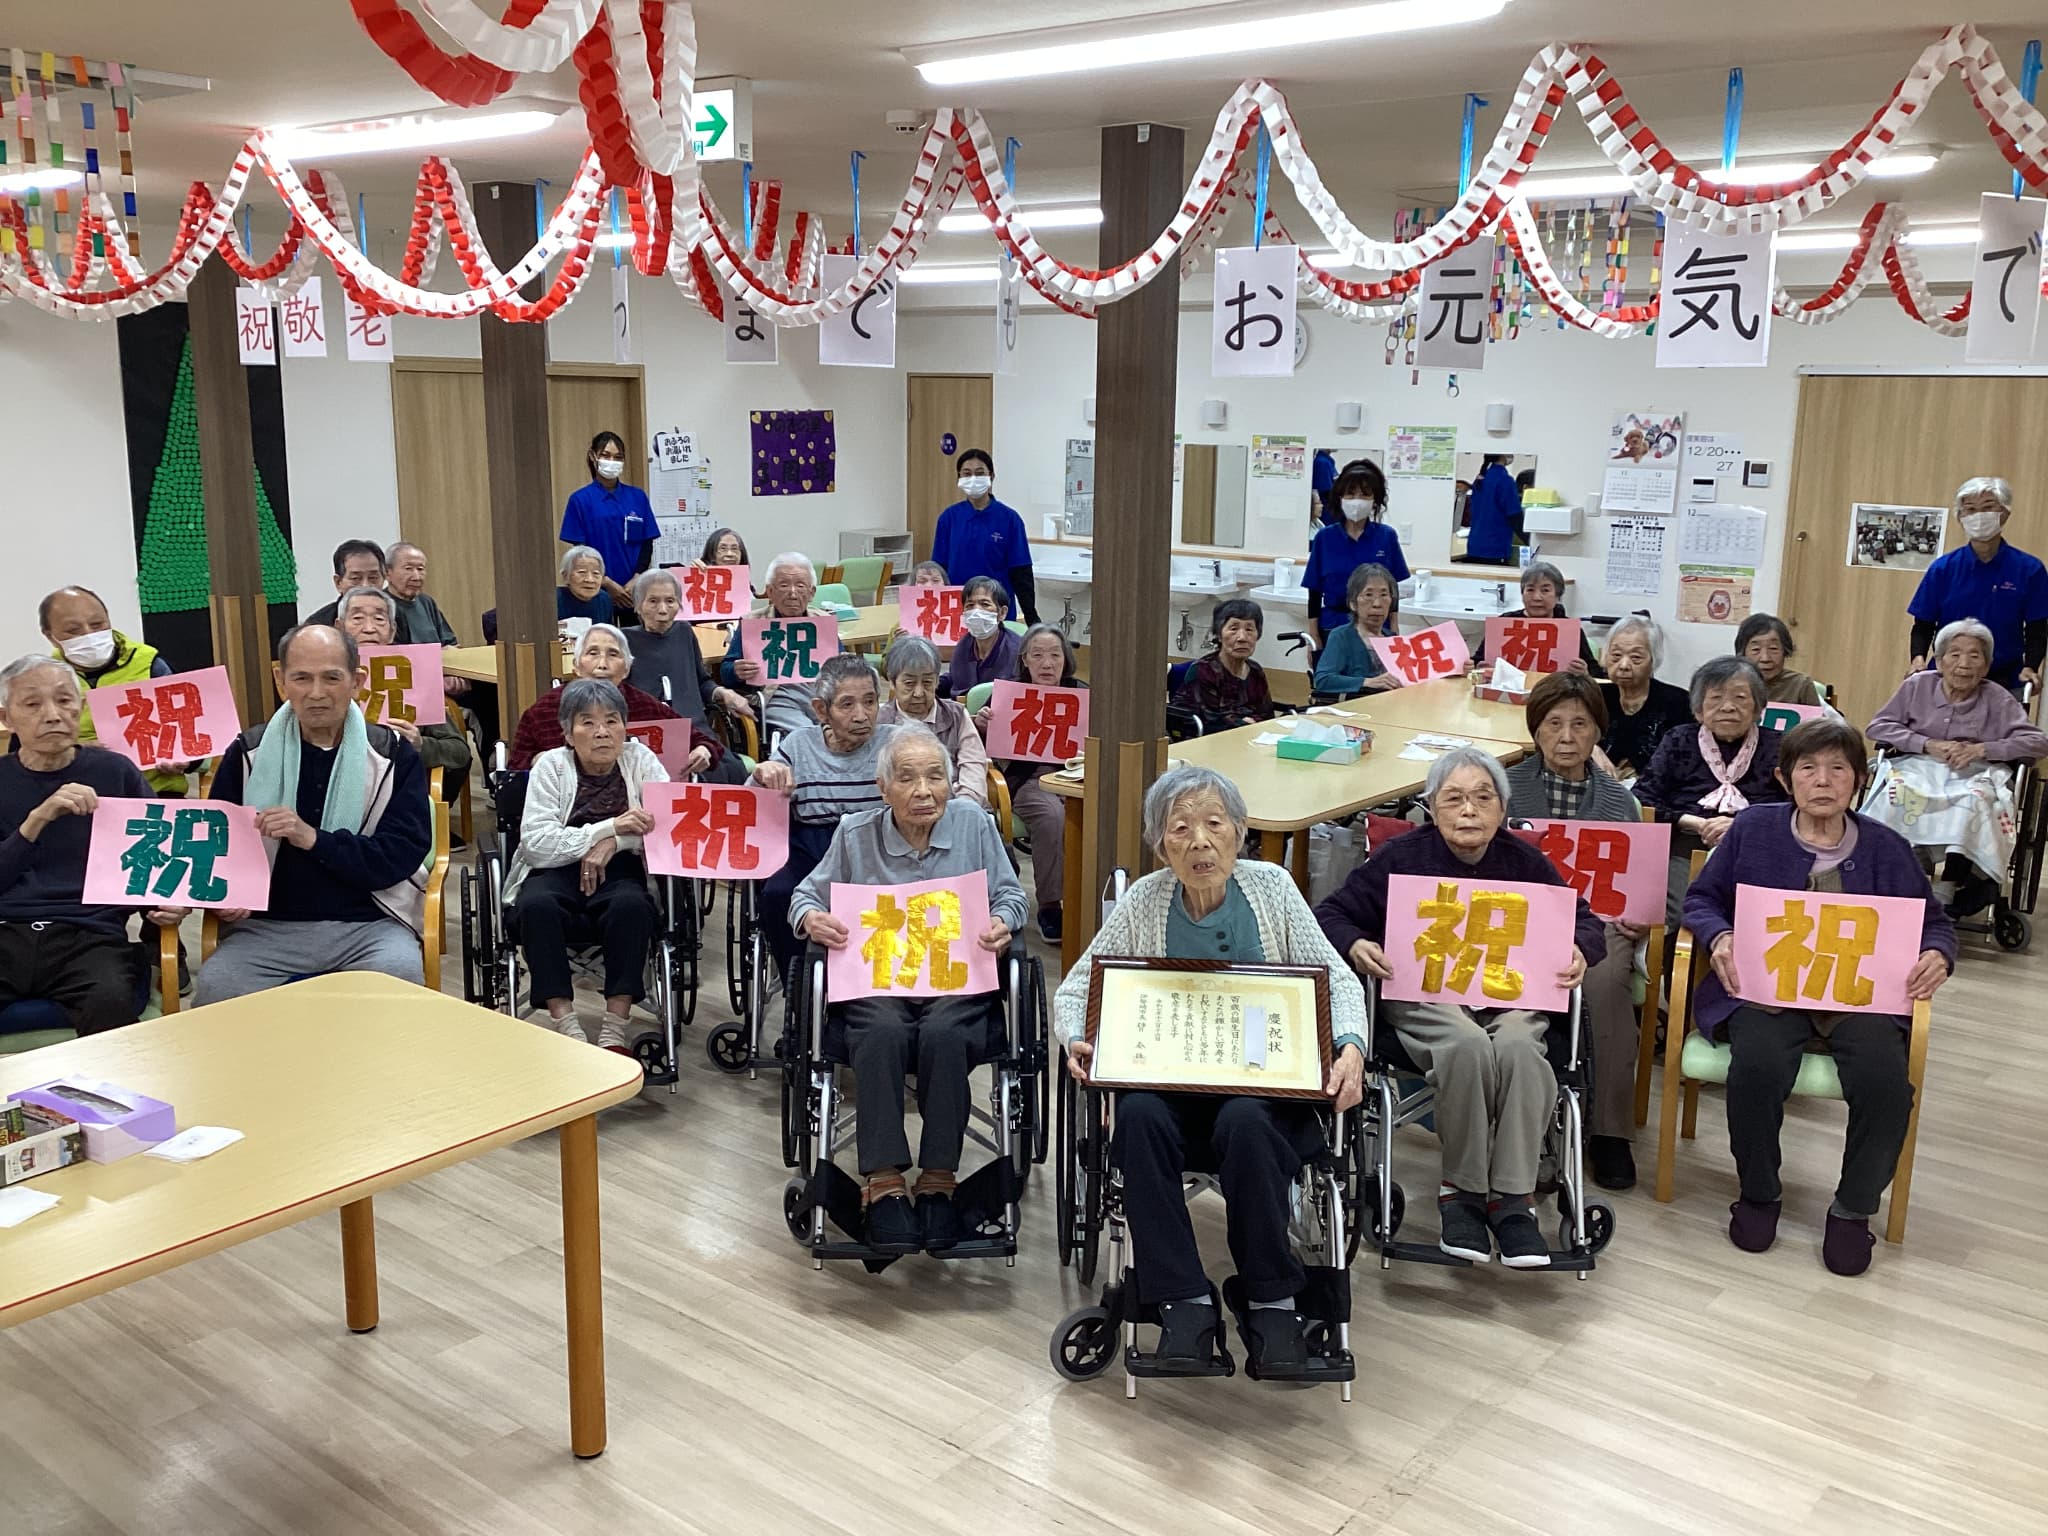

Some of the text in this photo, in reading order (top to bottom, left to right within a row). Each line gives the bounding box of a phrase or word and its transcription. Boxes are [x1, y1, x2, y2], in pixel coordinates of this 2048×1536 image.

[1423, 269, 1484, 344] 元
[1669, 247, 1760, 340] 気
[1983, 230, 2043, 323] で
[240, 303, 272, 351] 祝
[283, 295, 324, 343] 敬
[1225, 280, 1283, 351] お
[664, 435, 690, 446] おふろの
[670, 455, 689, 464] ました
[1716, 461, 1734, 472] 27
[1687, 509, 1697, 517] 12
[685, 568, 732, 614] 祝
[917, 591, 967, 643] 祝
[763, 622, 819, 679] 祝
[1390, 631, 1453, 680] 祝
[1502, 620, 1558, 673] 祝
[117, 683, 212, 767] 祝
[1011, 689, 1079, 759] 祝
[121, 804, 229, 901] 祝
[671, 786, 758, 869] 祝
[1542, 824, 1630, 917] 祝
[862, 891, 967, 990] 祝
[1415, 883, 1528, 1001] 祝
[1765, 900, 1879, 1006] 祝
[1268, 1013, 1283, 1053] 慶祝状
